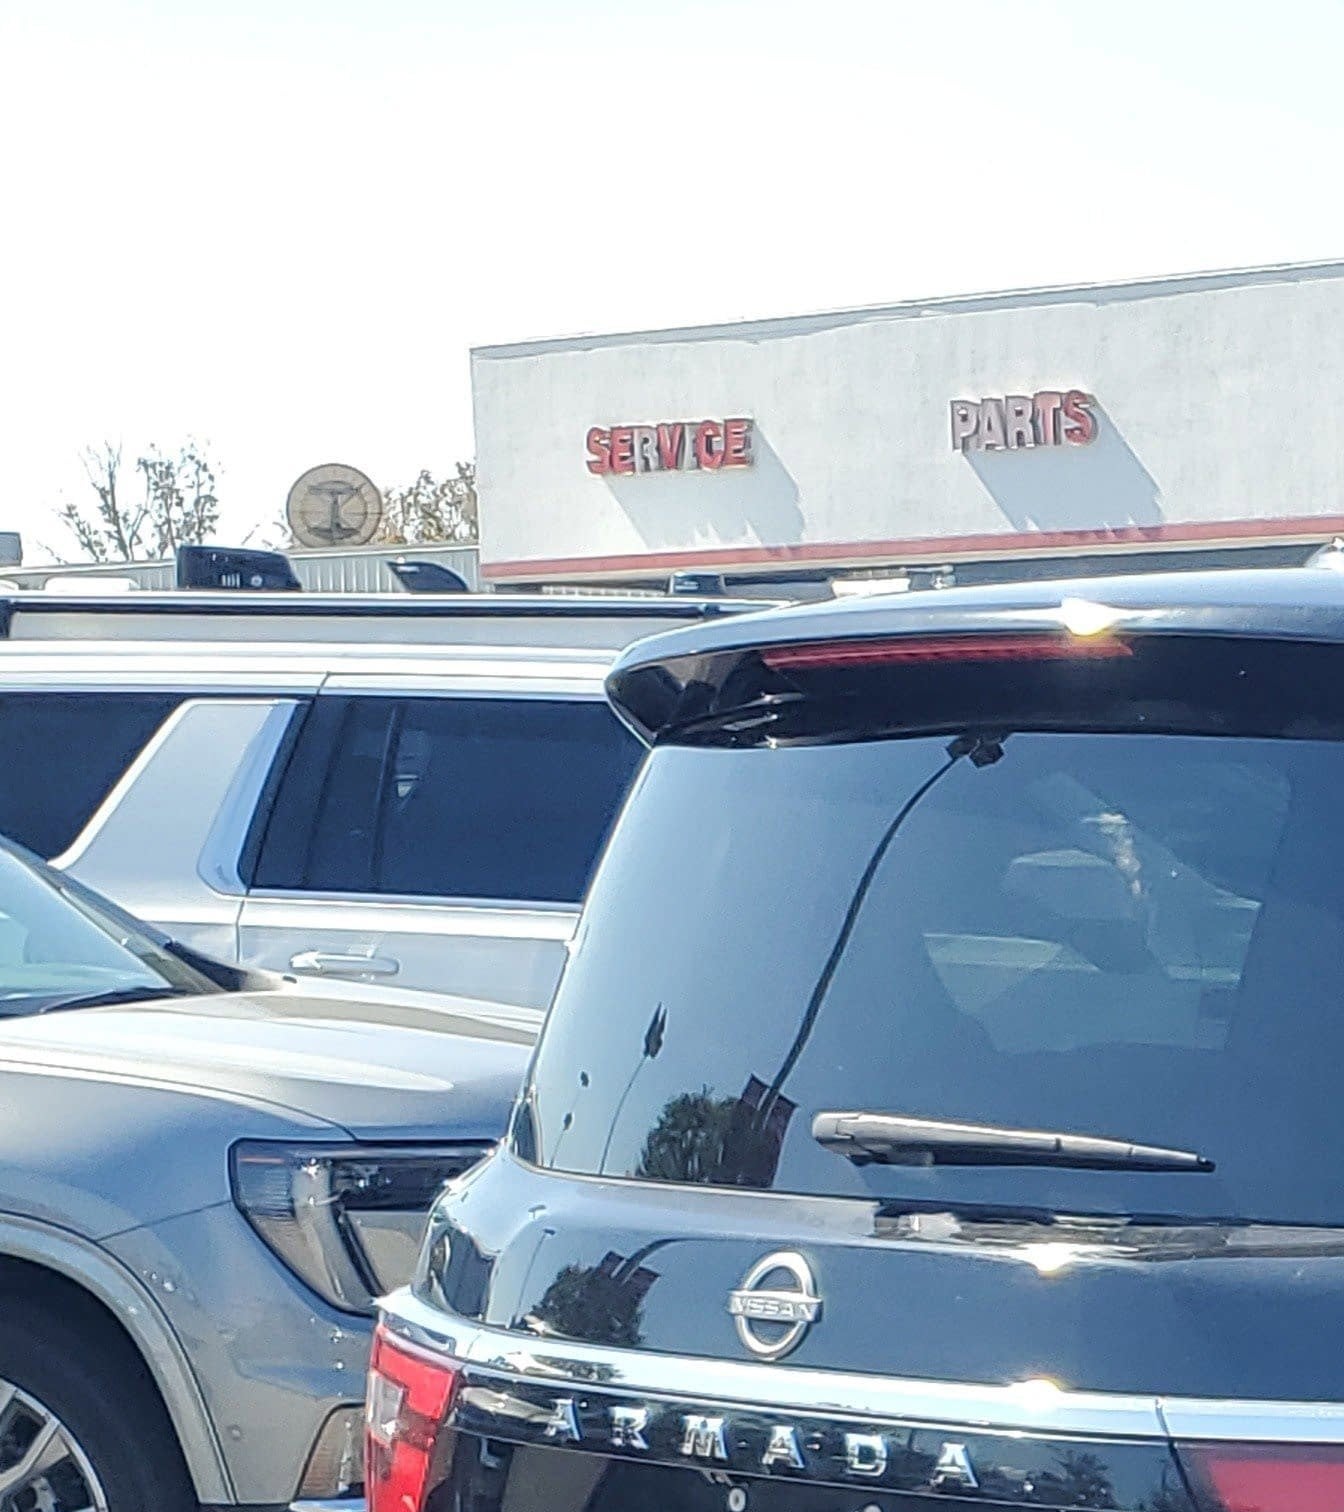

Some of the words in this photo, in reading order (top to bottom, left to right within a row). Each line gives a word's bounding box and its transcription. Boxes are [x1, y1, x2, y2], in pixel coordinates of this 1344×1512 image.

[585, 418, 754, 474] SERVICE
[951, 390, 1098, 452] PARTS
[543, 1396, 979, 1489] ARMADA
